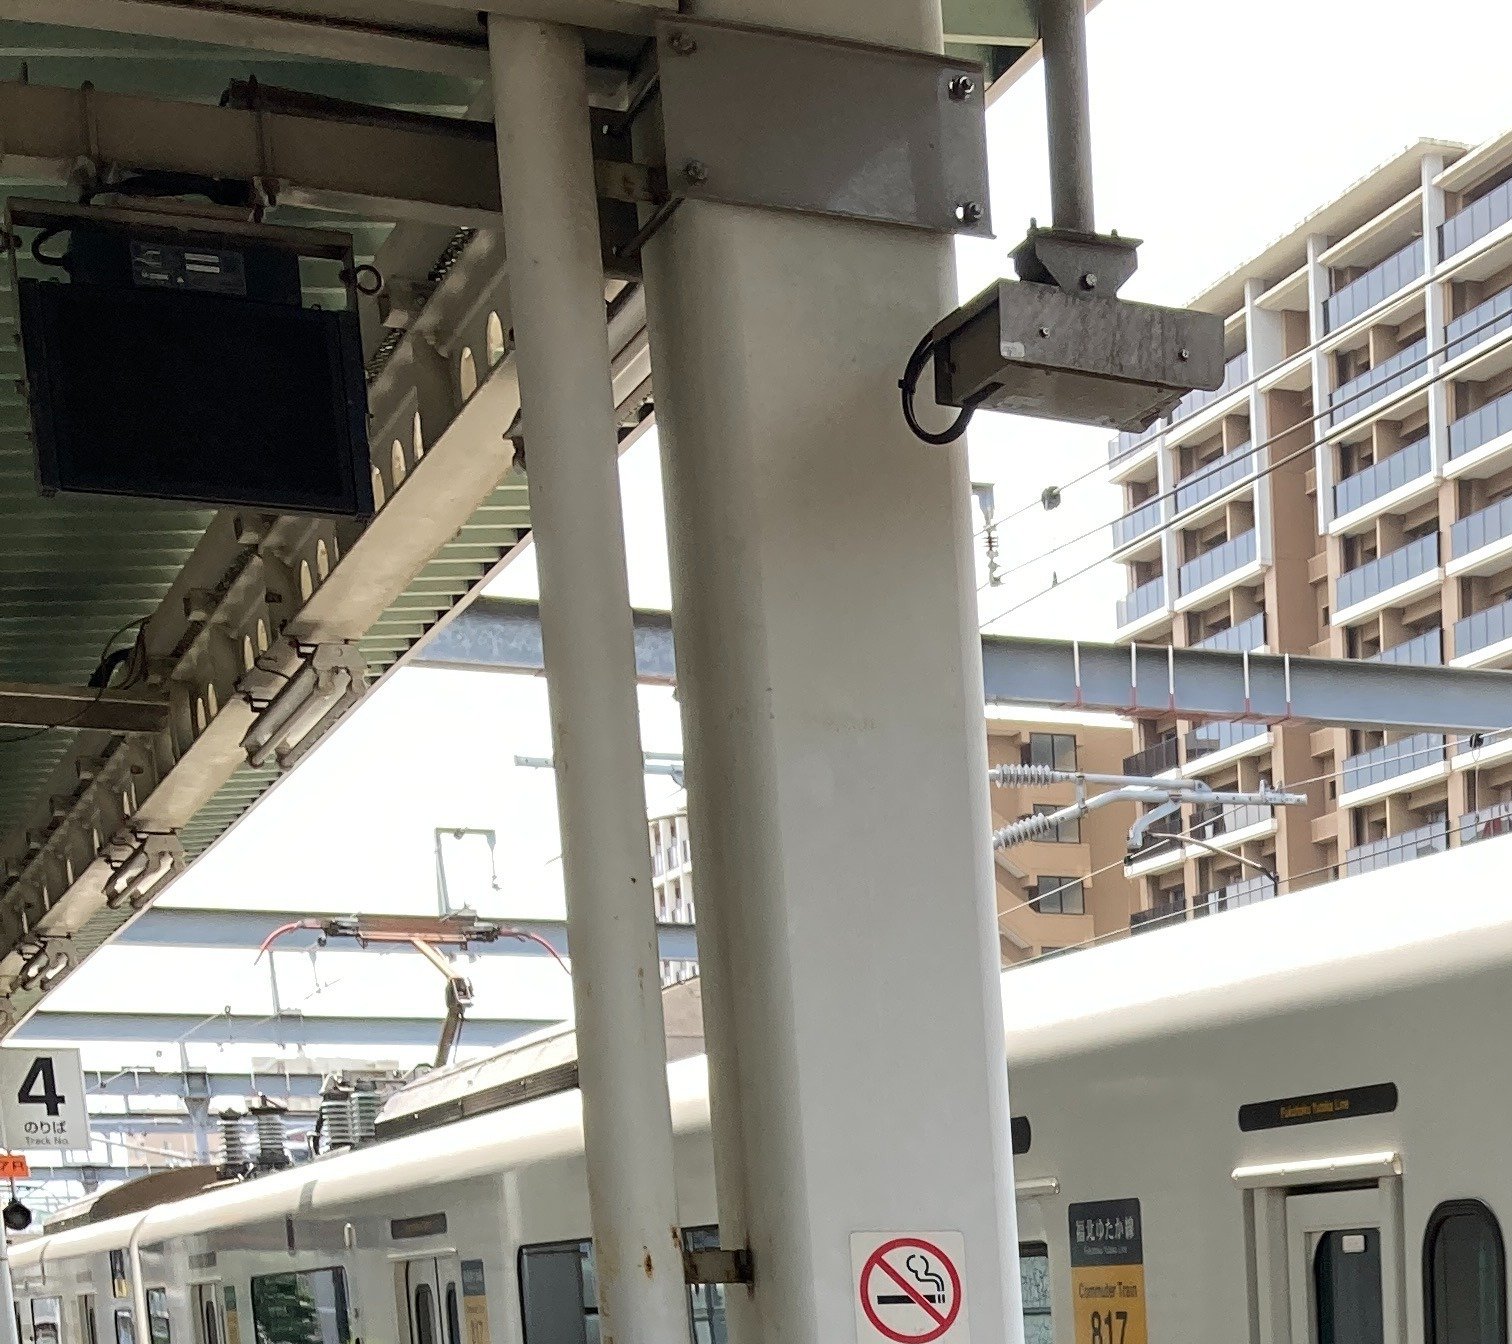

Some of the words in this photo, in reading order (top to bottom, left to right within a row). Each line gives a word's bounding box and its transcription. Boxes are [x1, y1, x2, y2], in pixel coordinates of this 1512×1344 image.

[18, 1057, 65, 1116] 4
[24, 1121, 67, 1134] のりば
[25, 1136, 51, 1145] Track
